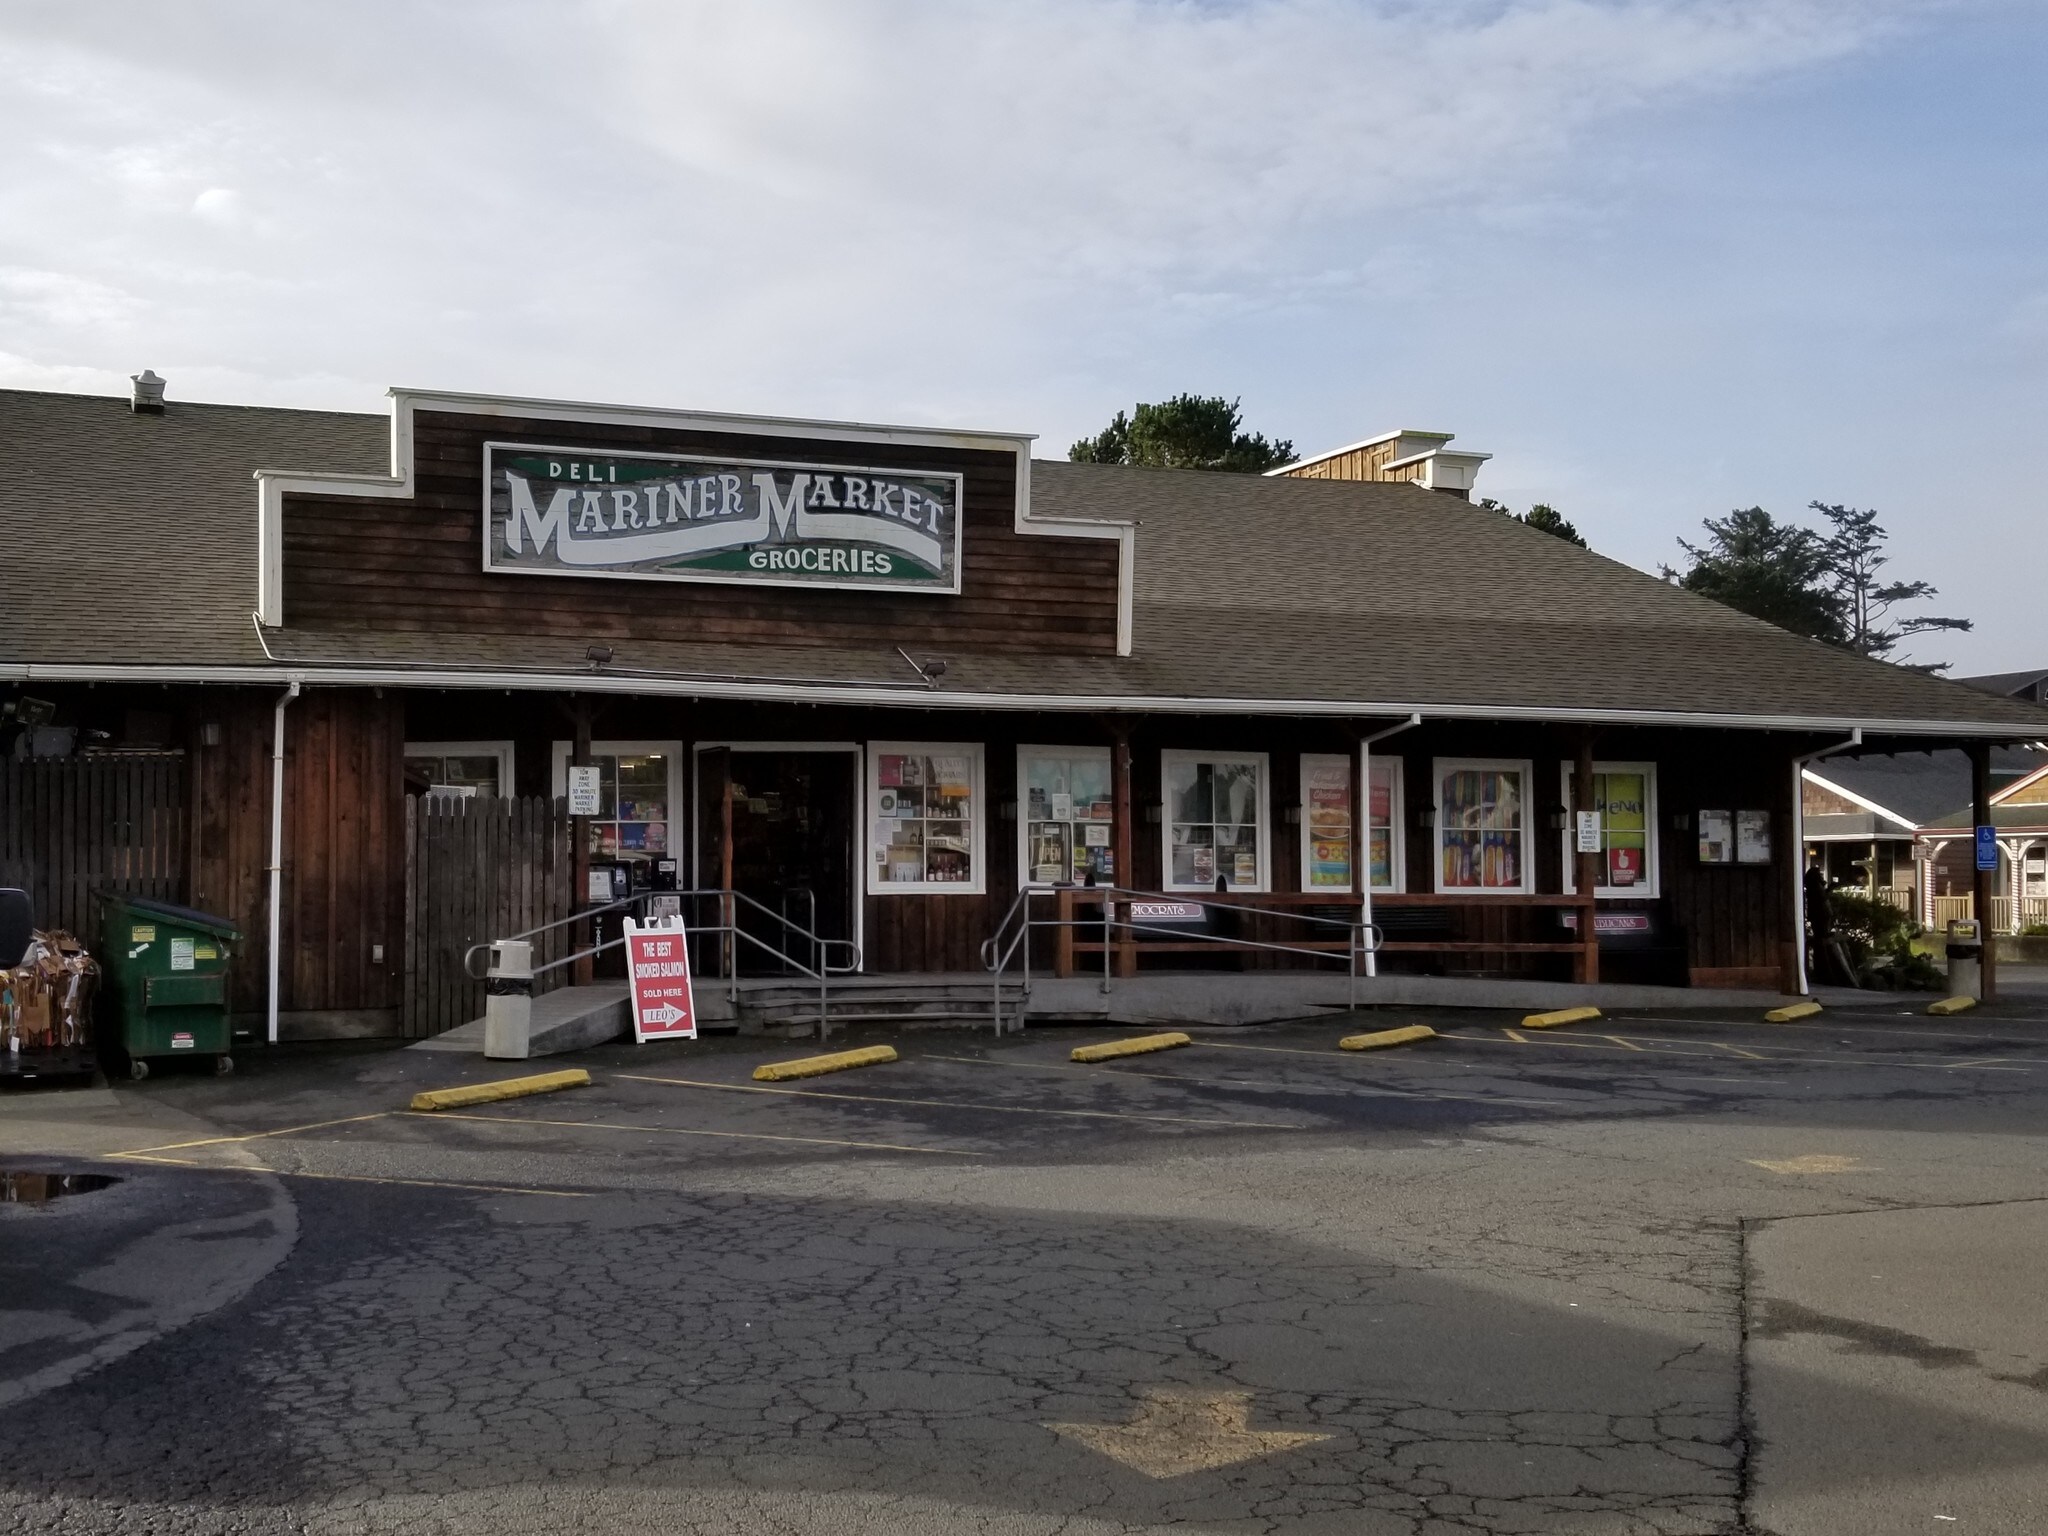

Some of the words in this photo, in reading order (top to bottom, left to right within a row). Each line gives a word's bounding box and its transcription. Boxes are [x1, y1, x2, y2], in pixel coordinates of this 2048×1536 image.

[549, 462, 616, 482] DELI
[505, 471, 744, 563] MARINER
[752, 473, 944, 544] MARKET
[749, 548, 892, 574] GROCERIES
[1131, 904, 1186, 916] MOCRATS
[1594, 918, 1637, 928] UBLICANS
[642, 942, 655, 958] THE
[656, 941, 672, 957] BEST
[635, 962, 661, 979] SMOKED
[660, 961, 685, 978] SALMON
[643, 988, 662, 998] SOLD
[663, 987, 683, 997] HERE
[650, 1009, 676, 1021] LEO'S
